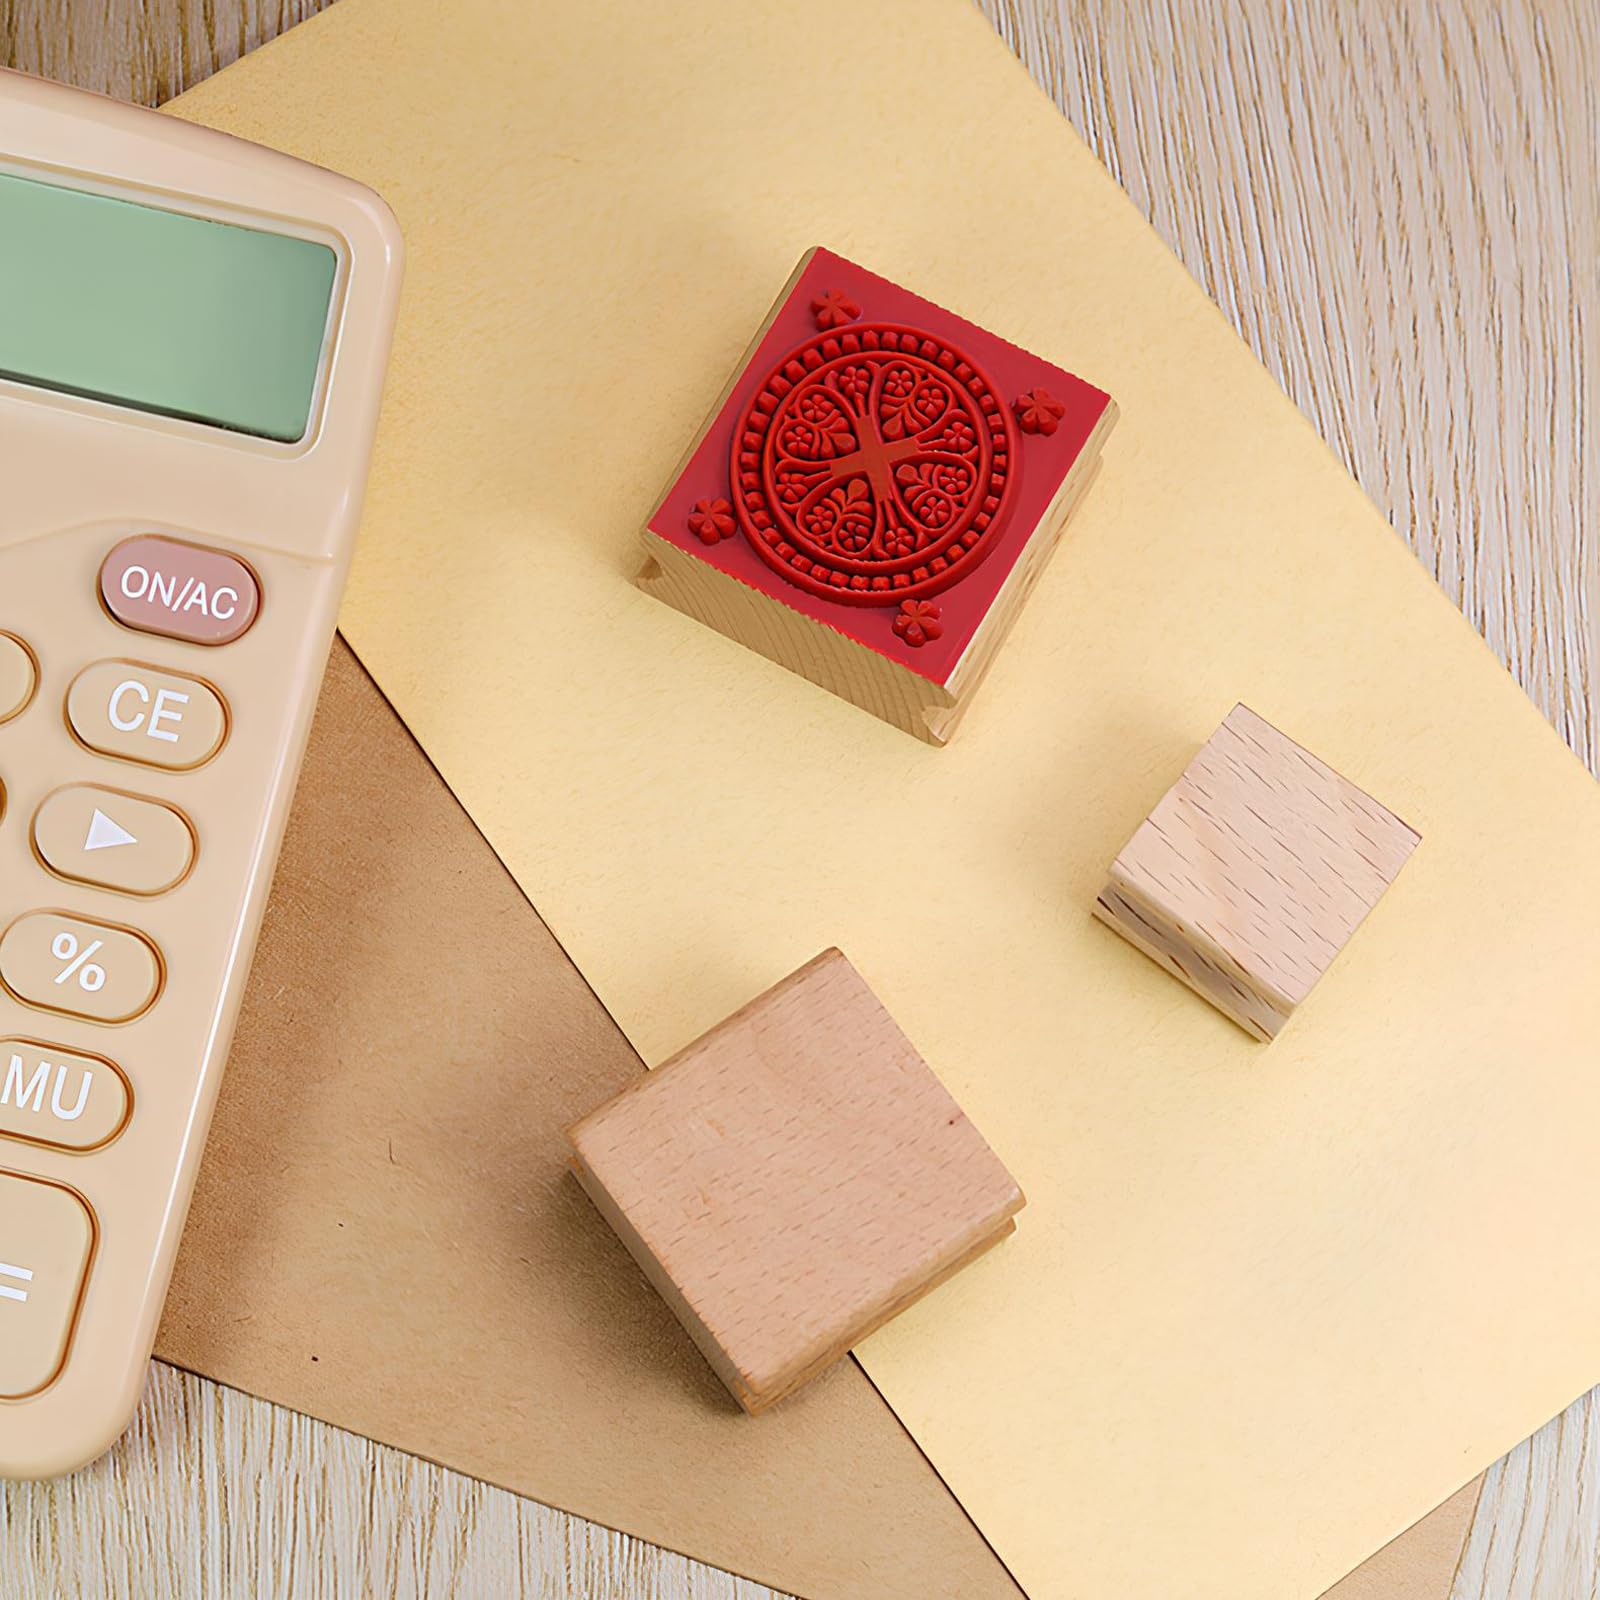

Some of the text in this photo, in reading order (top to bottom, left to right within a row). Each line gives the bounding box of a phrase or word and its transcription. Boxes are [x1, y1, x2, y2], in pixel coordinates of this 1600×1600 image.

[121, 566, 238, 619] ON/AC
[108, 681, 190, 742] CE
[51, 932, 106, 992] %
[0, 1054, 93, 1120] MU
